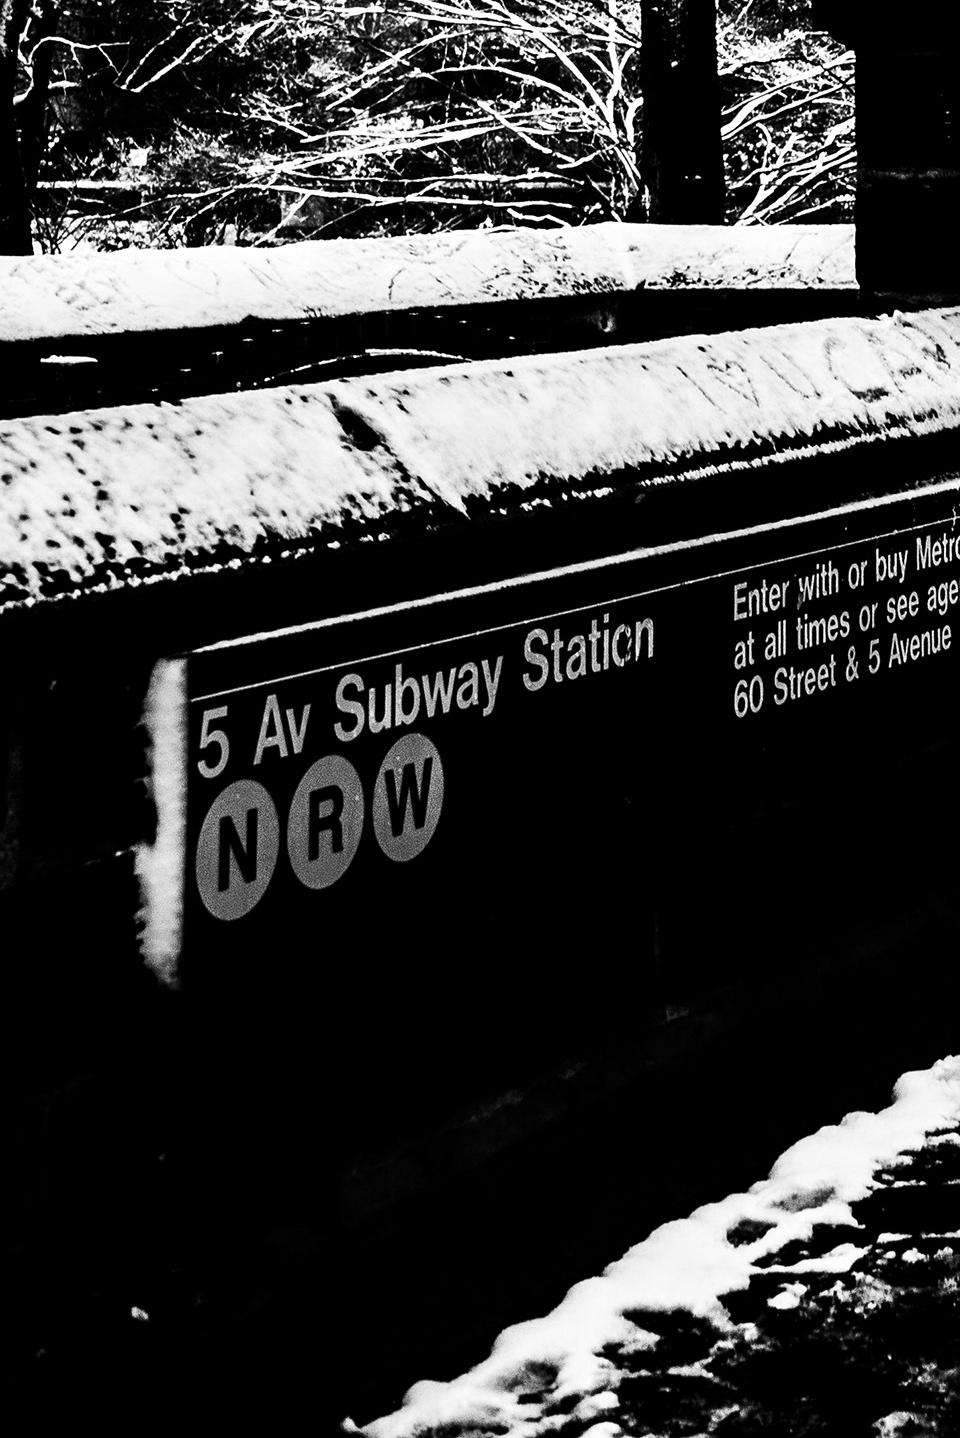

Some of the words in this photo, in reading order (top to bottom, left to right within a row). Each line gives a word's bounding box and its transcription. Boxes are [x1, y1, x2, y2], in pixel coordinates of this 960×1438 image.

[734, 579, 789, 621] Enter
[799, 561, 839, 602] with
[848, 560, 867, 589] or
[876, 548, 908, 583] buy
[734, 631, 754, 669] at
[765, 620, 786, 660] all
[796, 611, 850, 650] times
[859, 603, 878, 631] or
[887, 591, 919, 623] see
[198, 706, 229, 778] 5
[253, 694, 310, 765] Av
[334, 656, 503, 742] Subway
[523, 614, 654, 691] Station
[734, 675, 763, 718] 60
[774, 654, 836, 705] Street
[846, 646, 859, 682] &
[869, 639, 880, 674] 5
[889, 625, 951, 668] Avenue
[384, 757, 435, 838] W
